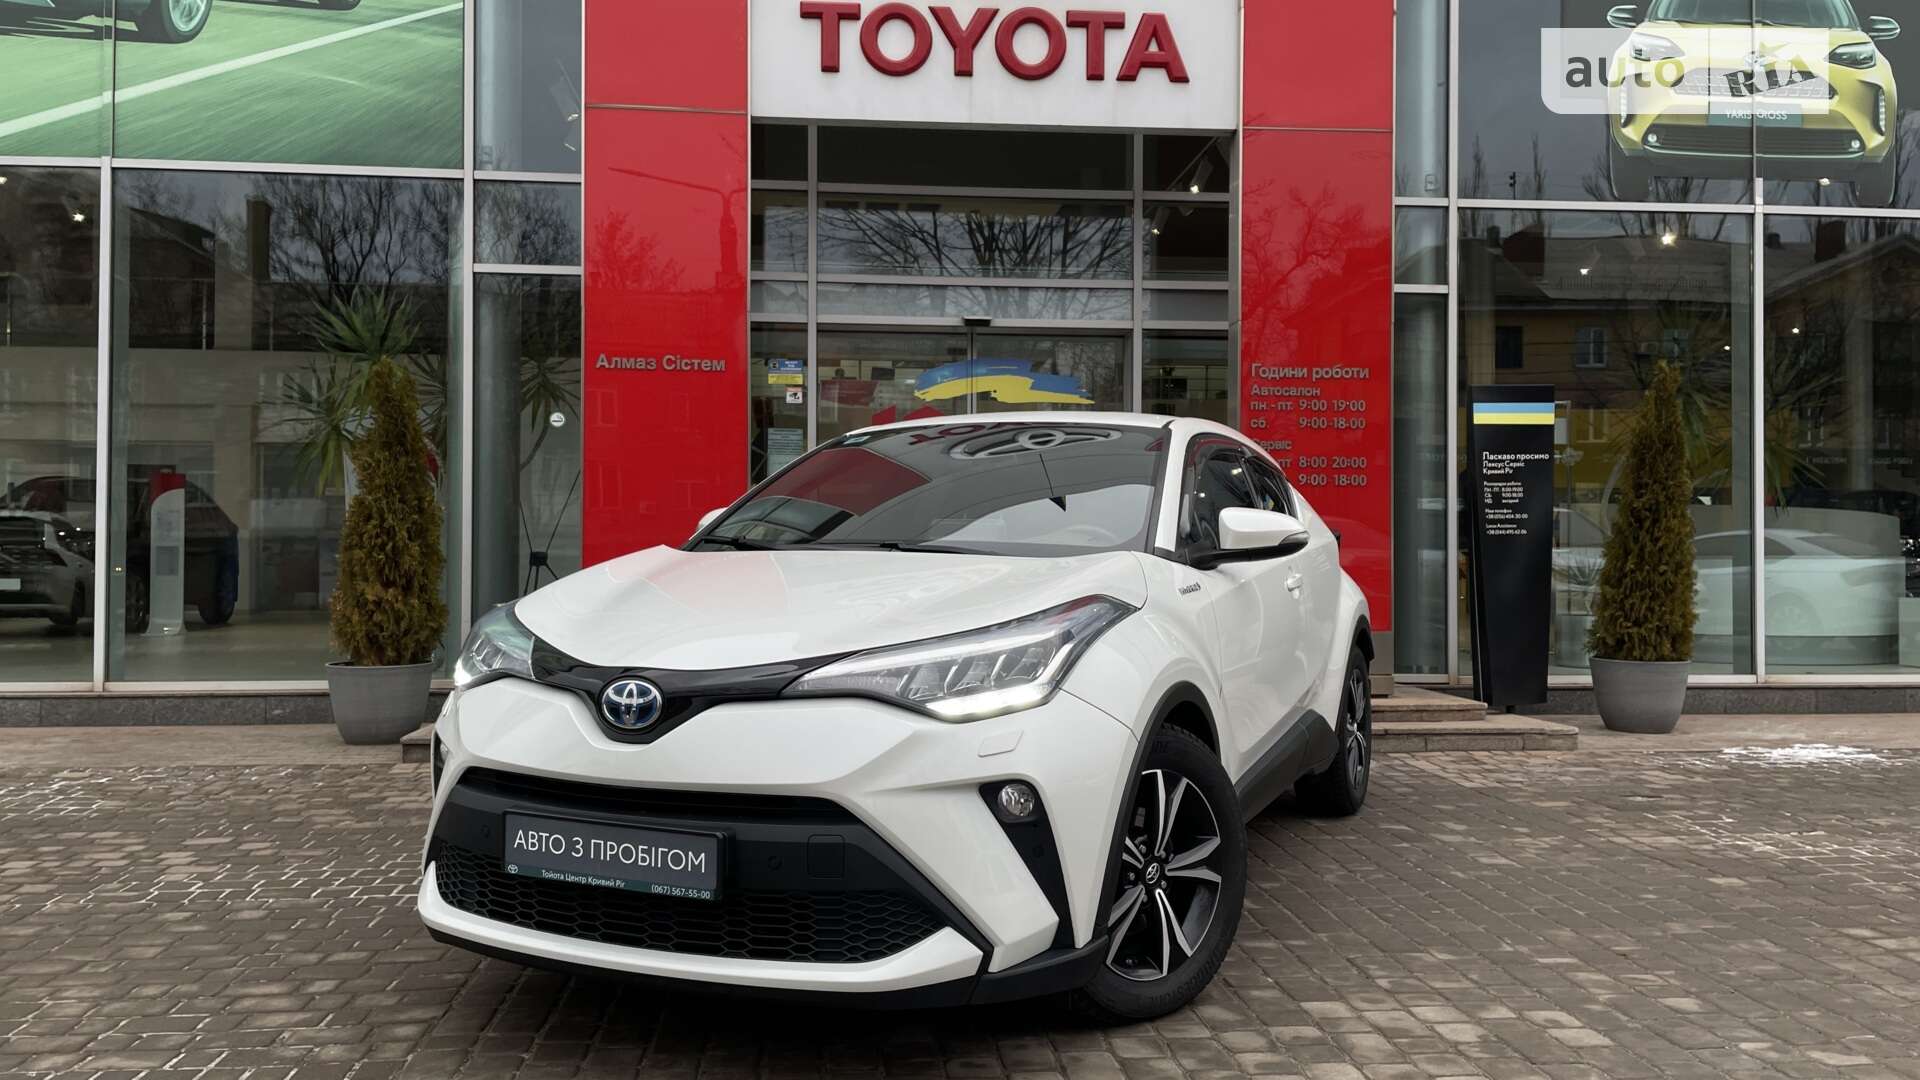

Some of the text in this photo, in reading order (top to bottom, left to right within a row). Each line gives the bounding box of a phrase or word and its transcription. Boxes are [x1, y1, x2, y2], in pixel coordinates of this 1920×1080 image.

[799, 1, 1190, 83] TOYOTA
[596, 353, 726, 372] Алмаз Сістем
[1251, 363, 1370, 382] Години роботи
[1251, 385, 1321, 397] Автосалон
[513, 829, 706, 873] АВТО З ПРОБІГОМ
[541, 869, 626, 889] Тойота Центр Кривий Ріг
[651, 884, 712, 899] (067) 567-55-00
